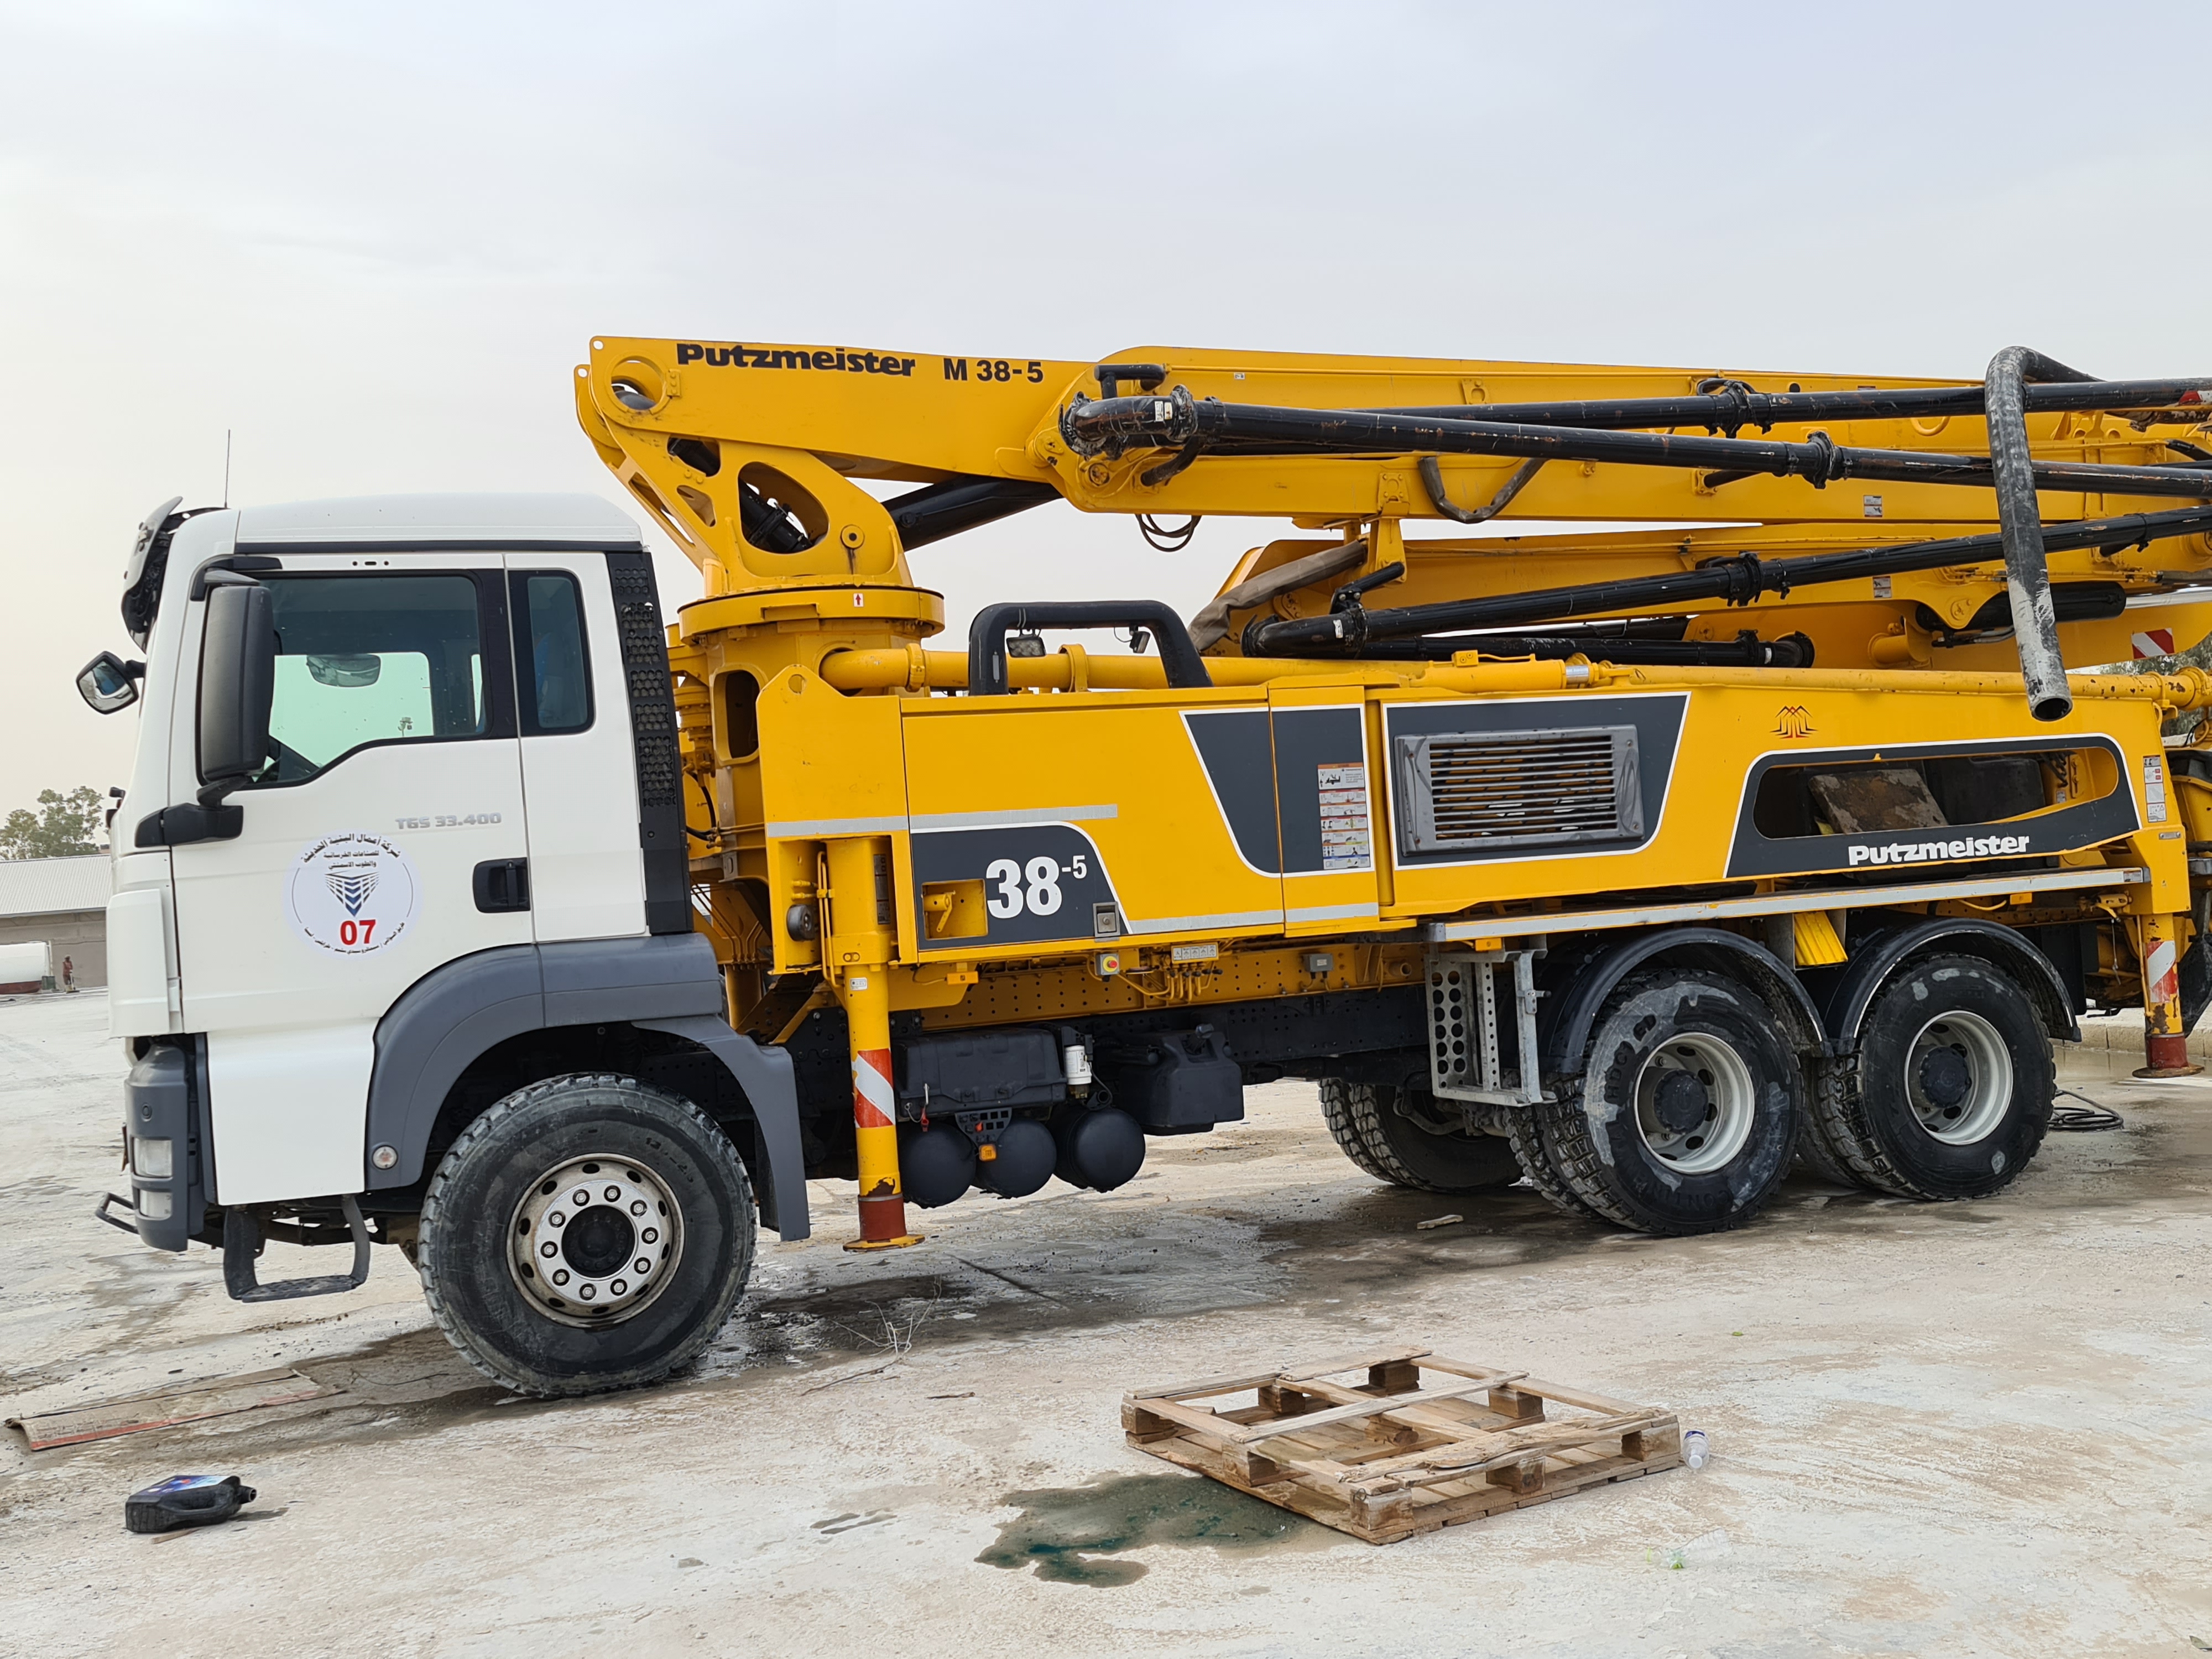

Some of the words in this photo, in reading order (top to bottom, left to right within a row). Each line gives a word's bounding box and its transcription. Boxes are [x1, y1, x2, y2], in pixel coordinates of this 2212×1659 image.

[677, 343, 916, 377] Putzmeister
[943, 358, 967, 380] M
[976, 359, 1044, 383] 38-5
[395, 817, 430, 830] TGS
[434, 812, 502, 827] 33.400
[328, 833, 354, 846] البنية
[357, 834, 382, 846] أعمال
[381, 840, 401, 858] شركة
[301, 840, 328, 863] الحديثة
[1848, 836, 2030, 865] Putzmeister
[340, 919, 376, 946] 07
